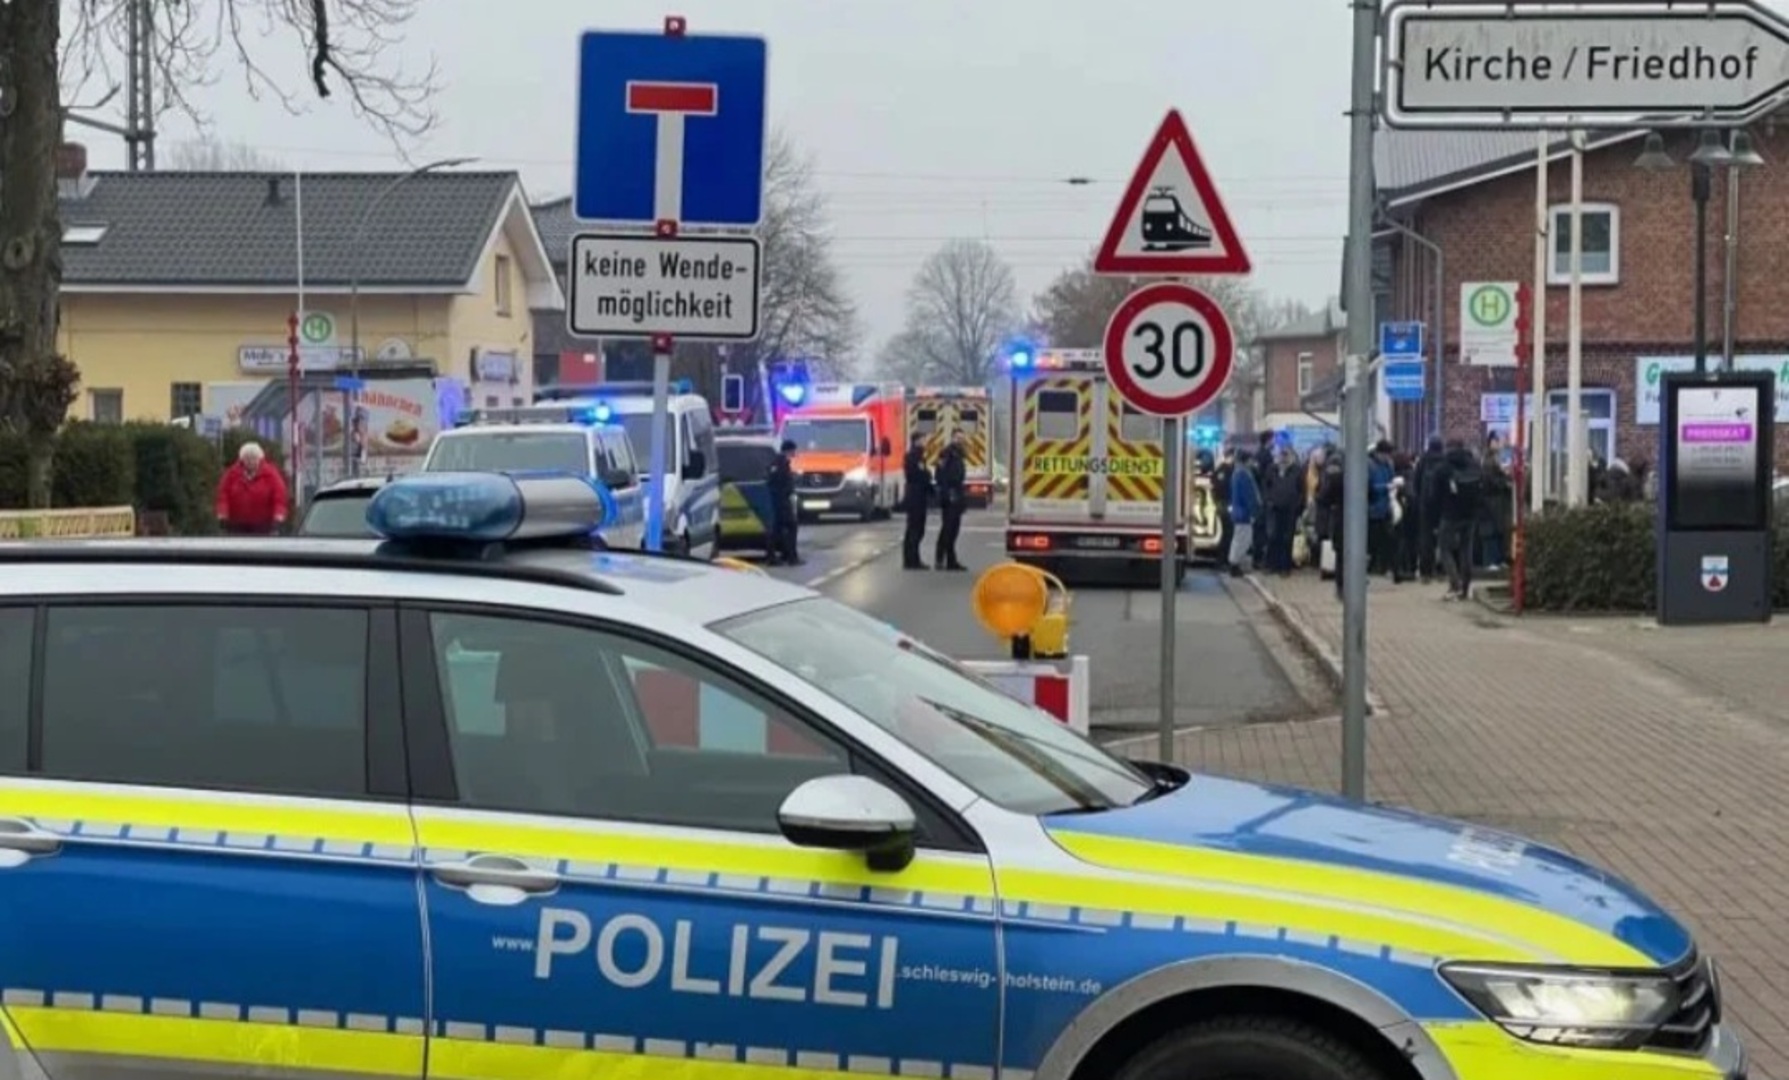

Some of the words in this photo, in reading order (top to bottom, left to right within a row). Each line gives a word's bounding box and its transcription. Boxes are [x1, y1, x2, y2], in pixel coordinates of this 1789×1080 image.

[1424, 46, 1552, 81] Kirche
[1587, 45, 1760, 81] Friedhof
[584, 248, 647, 278] keine
[659, 250, 748, 280] Wende-
[597, 288, 733, 323] möglichkeit
[1133, 320, 1205, 379] 30
[1034, 456, 1159, 474] RETTUNGSDIENST
[534, 906, 899, 1009] POLIZEI
